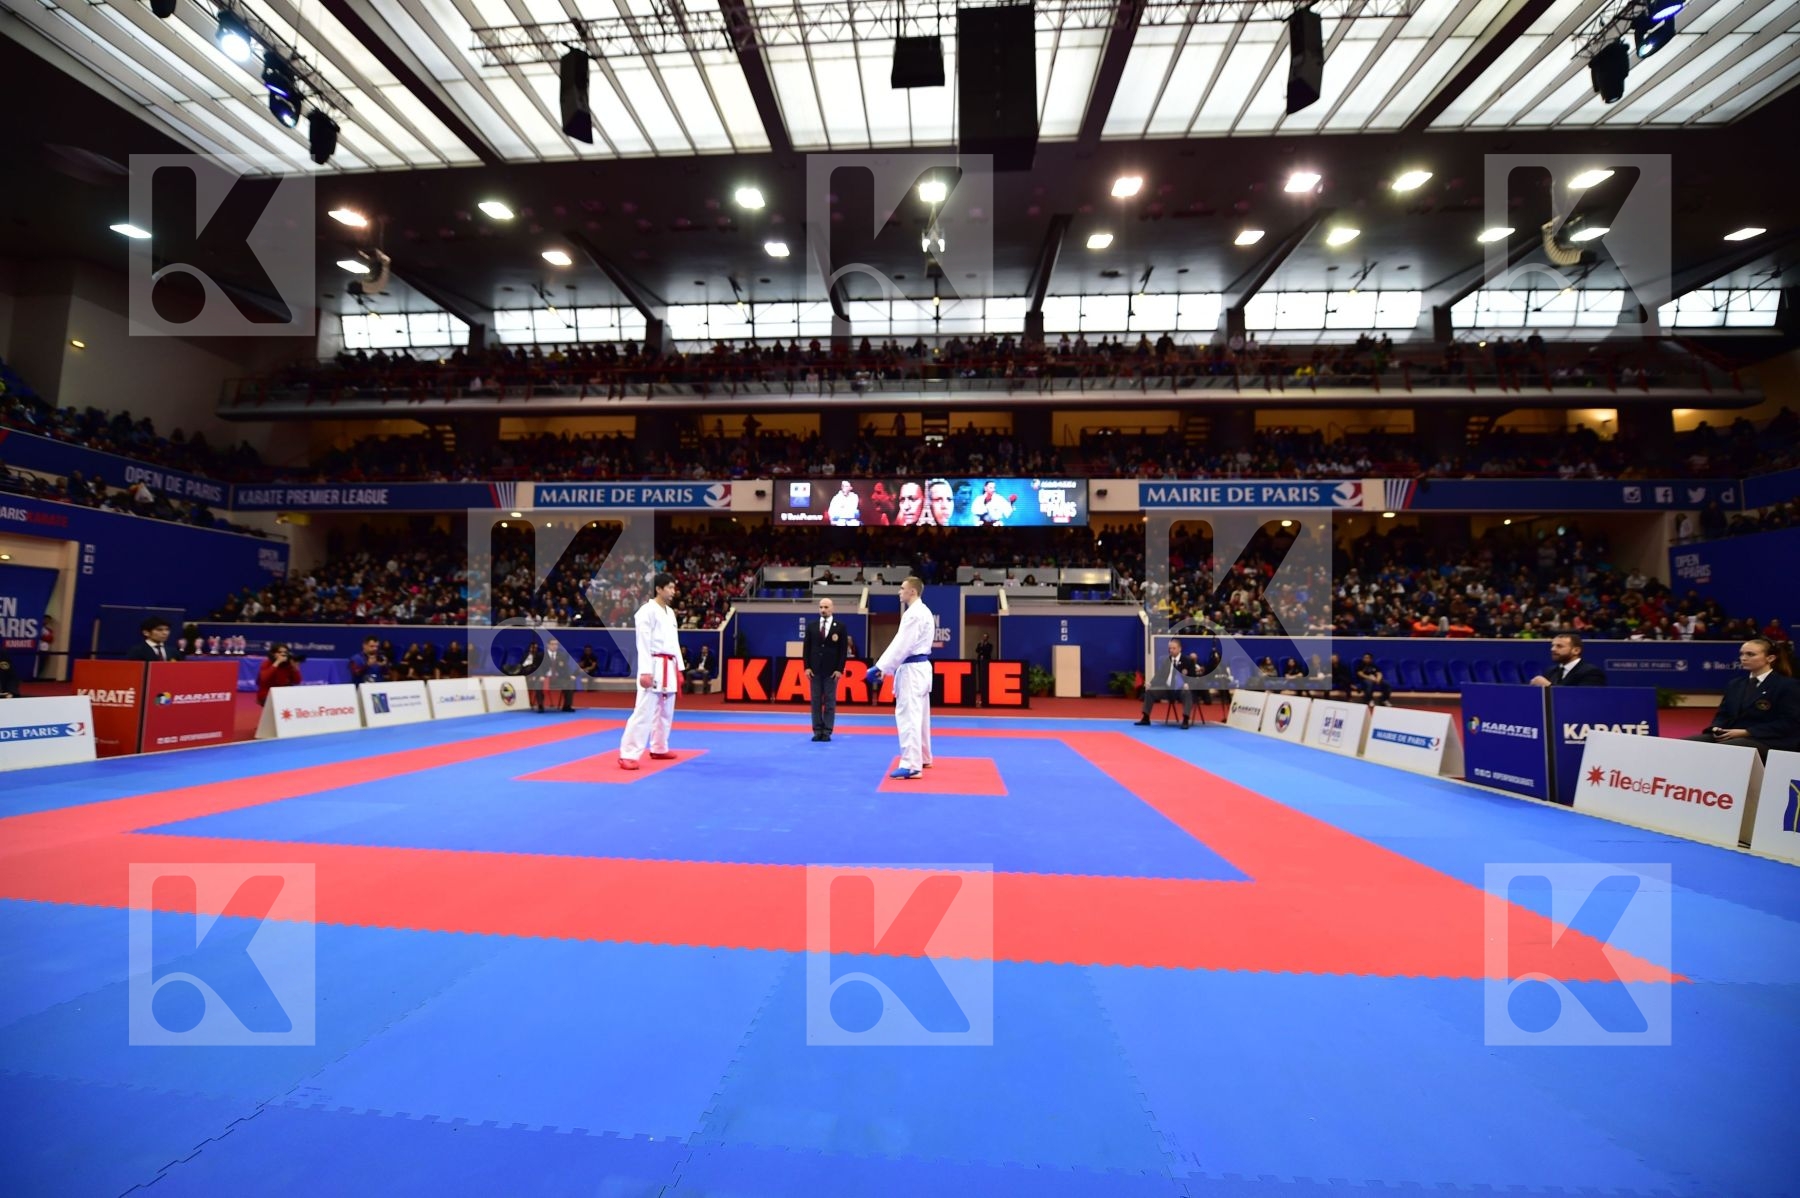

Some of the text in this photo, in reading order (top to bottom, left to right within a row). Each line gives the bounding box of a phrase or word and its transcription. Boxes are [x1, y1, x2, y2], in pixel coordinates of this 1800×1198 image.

[124, 465, 221, 502] OPEN DE PARIS
[238, 488, 389, 505] KARATE PREMIER LEAGUE
[540, 488, 693, 503] MAIRIE DE PARIS
[1147, 486, 1321, 502] MAIRIE DE PARIS
[0, 727, 59, 740] DE PARIS
[1609, 769, 1734, 810] îledeFrance
